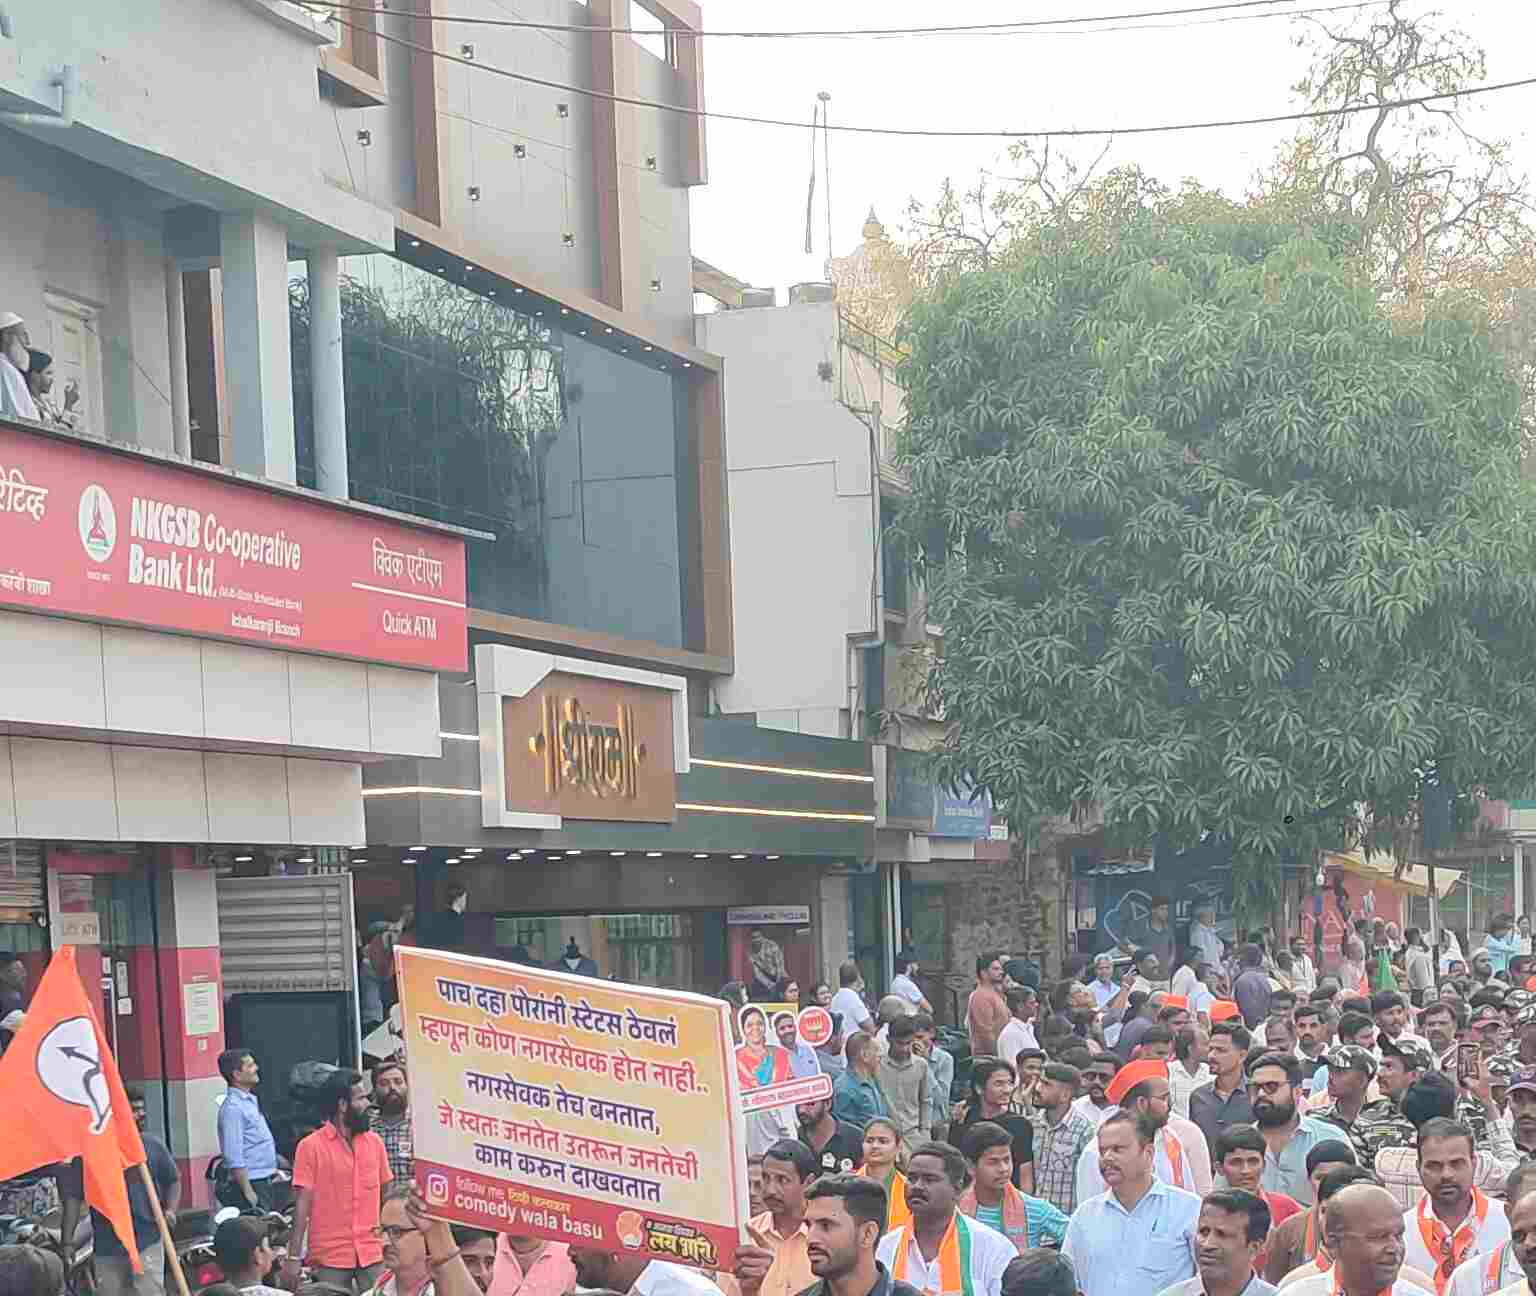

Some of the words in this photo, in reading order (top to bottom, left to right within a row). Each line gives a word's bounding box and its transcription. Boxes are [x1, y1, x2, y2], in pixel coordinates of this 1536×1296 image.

[130, 496, 202, 549] NKGSB
[203, 512, 302, 571] Co-operative
[128, 544, 183, 592] Bank
[184, 554, 218, 599] Ltd.
[383, 609, 413, 636] Quick
[413, 617, 438, 641] ATM
[437, 976, 472, 1007] पाच
[475, 984, 507, 1015] दहा
[511, 986, 567, 1026] पोरांनी
[570, 1001, 623, 1037] स्टेटस
[626, 1008, 678, 1047] ठेवलं
[417, 1015, 470, 1055] म्हणून
[474, 1022, 517, 1057] कोण
[520, 1037, 608, 1075] नगरसेवक
[611, 1052, 649, 1083] होत
[465, 1070, 552, 1110] नगरसेवक
[554, 1082, 585, 1113] तेच
[437, 1099, 457, 1130] जे
[502, 1116, 561, 1155] जनतेत
[626, 1145, 701, 1181] जनतेची
[474, 1142, 513, 1173] काम
[569, 1163, 662, 1204] दाखवतात
[454, 1191, 516, 1220] comedy
[520, 1206, 559, 1232] wala
[562, 1217, 604, 1242] basu
